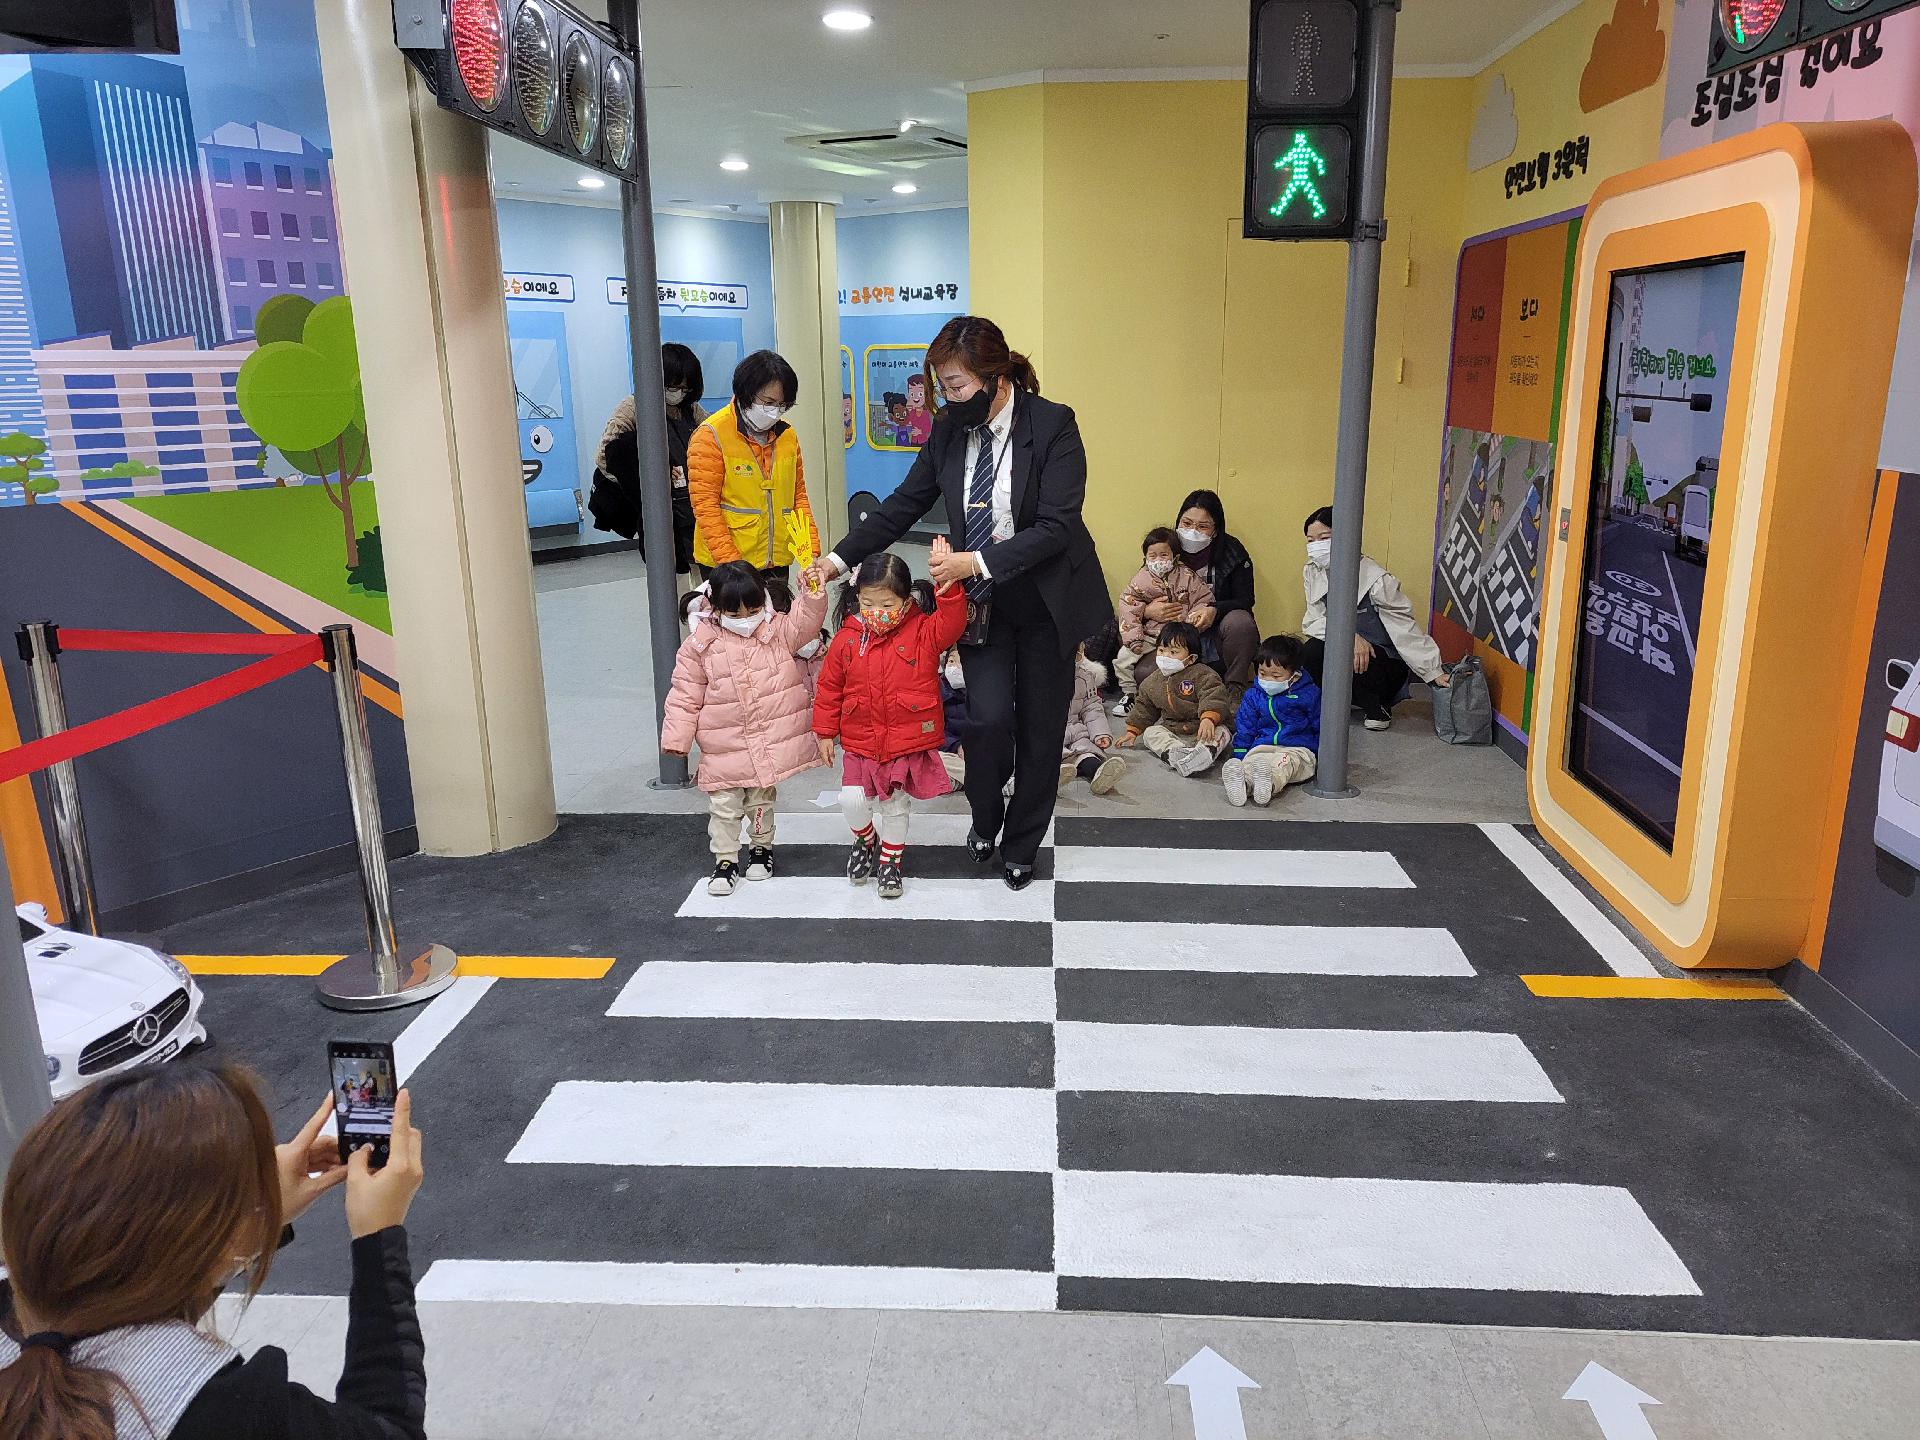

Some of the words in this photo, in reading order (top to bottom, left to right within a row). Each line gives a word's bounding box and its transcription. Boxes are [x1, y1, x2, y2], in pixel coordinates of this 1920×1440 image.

[1505, 152, 1550, 199] 안전보행
[1552, 135, 1589, 180] 3원칙
[680, 287, 736, 304] 뒷모습이에요
[851, 286, 895, 304] 교통안전
[899, 283, 959, 302] 실내교육장
[1520, 298, 1538, 321] 보다
[1631, 347, 1665, 378] 침착하게
[1667, 348, 1685, 380] 길을
[1587, 595, 1670, 643] 어린이
